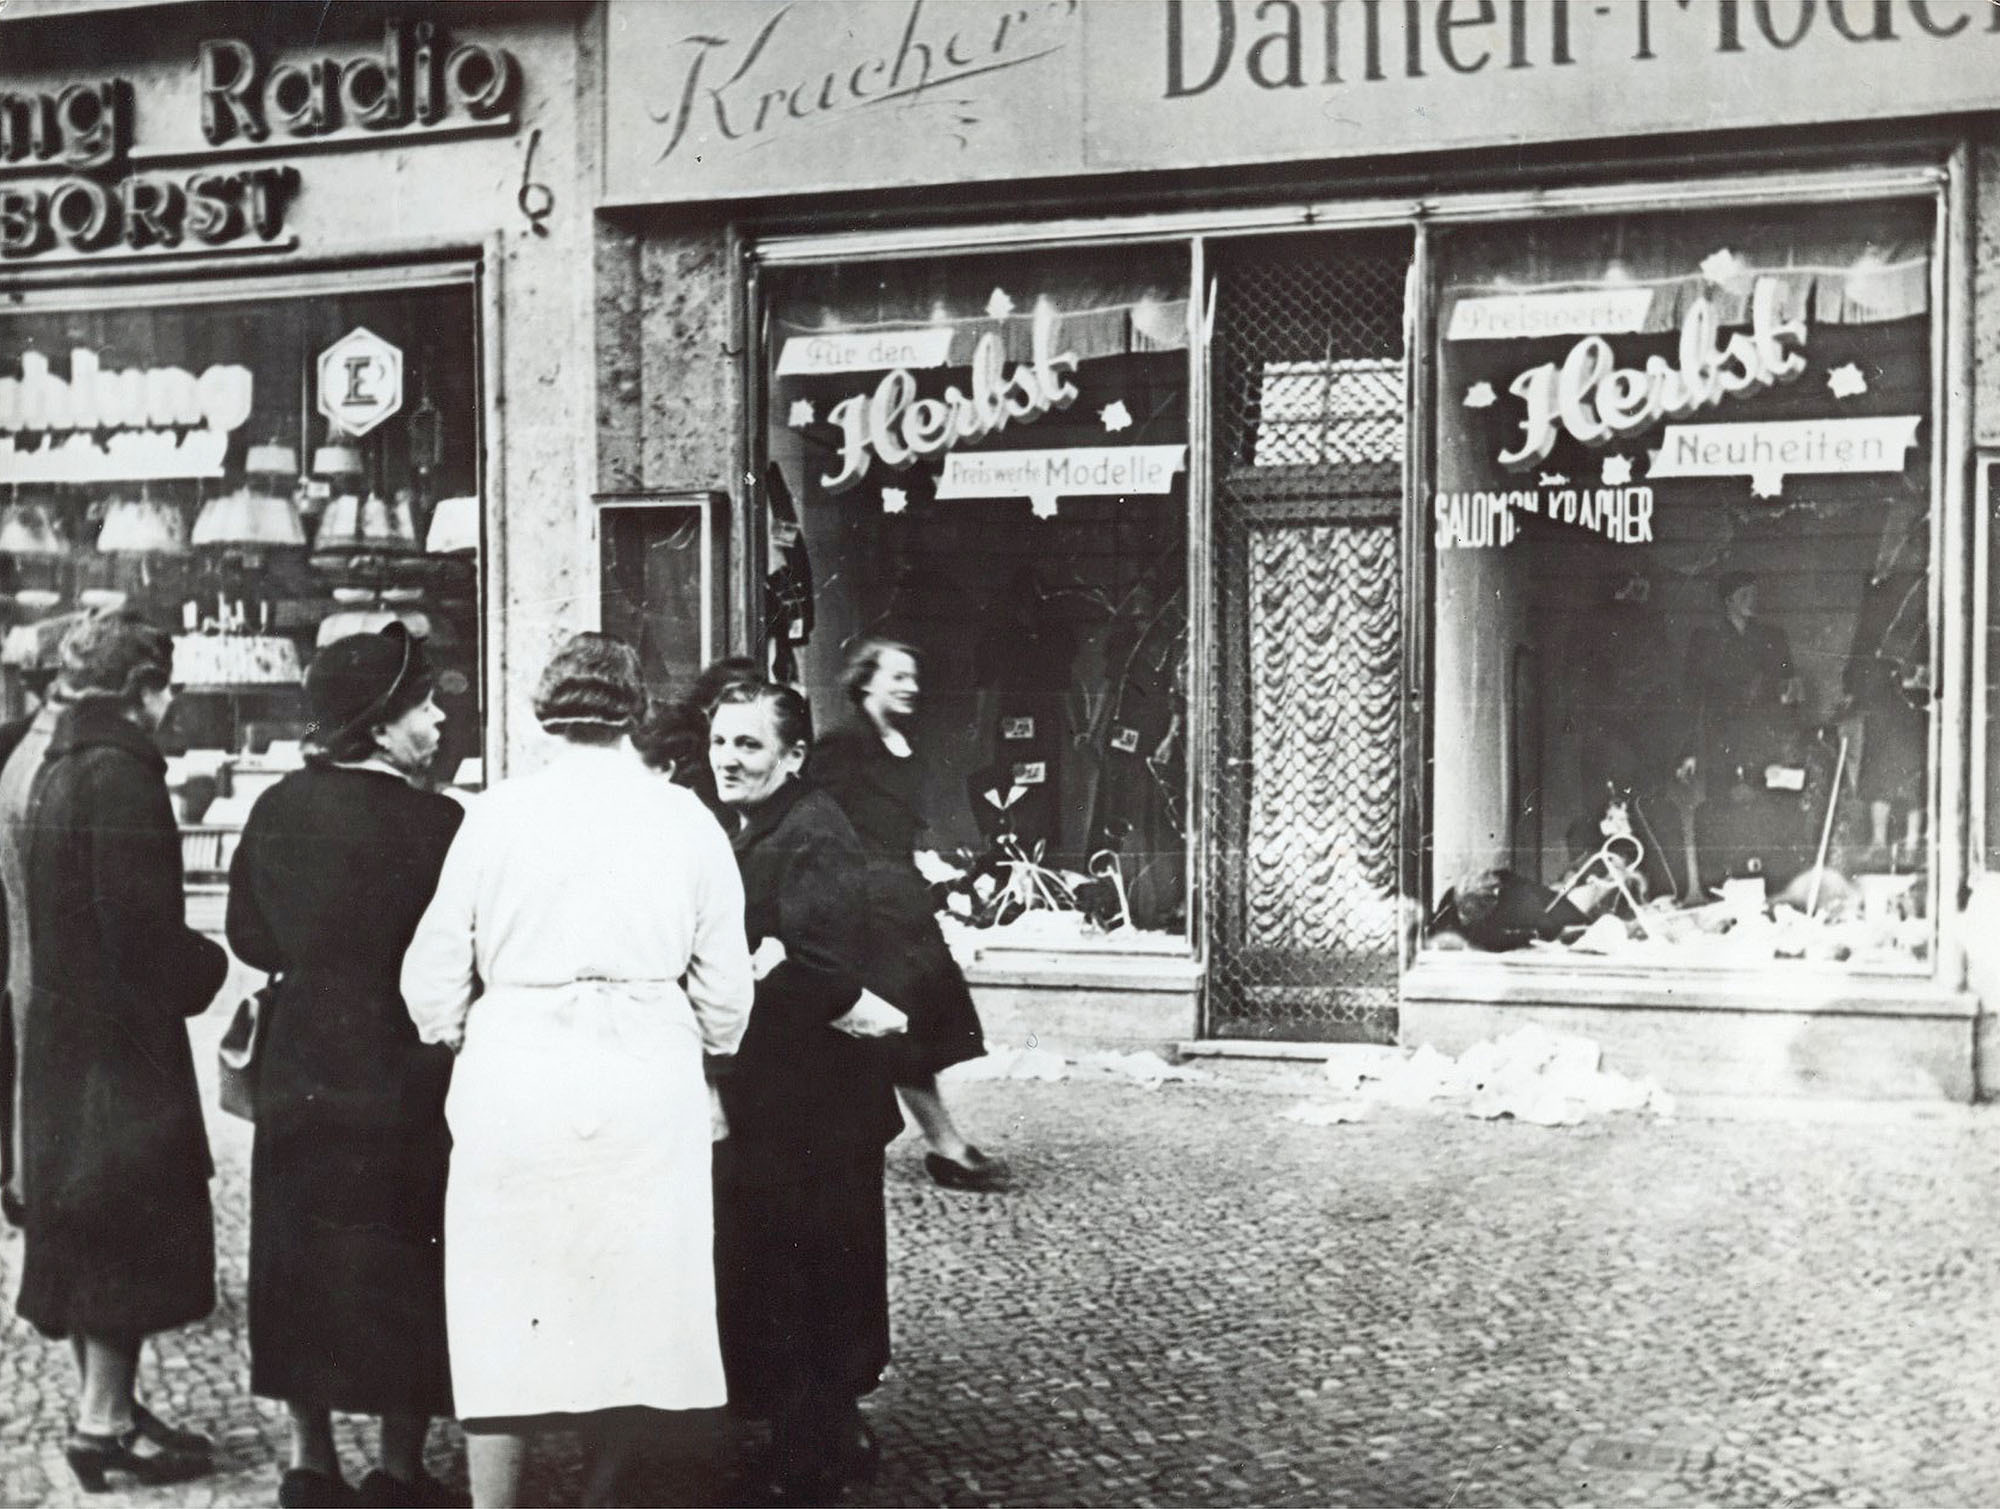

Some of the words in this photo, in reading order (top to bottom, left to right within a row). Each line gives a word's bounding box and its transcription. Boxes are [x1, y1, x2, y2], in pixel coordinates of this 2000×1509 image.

[200, 20, 523, 146] Radio
[867, 338, 917, 364] den
[1497, 276, 1807, 470] Herbst
[821, 293, 1080, 493] Herbst
[1045, 455, 1163, 487] Modelle
[1675, 430, 1885, 466] Neuheiten
[1434, 490, 1539, 549] SALOM
